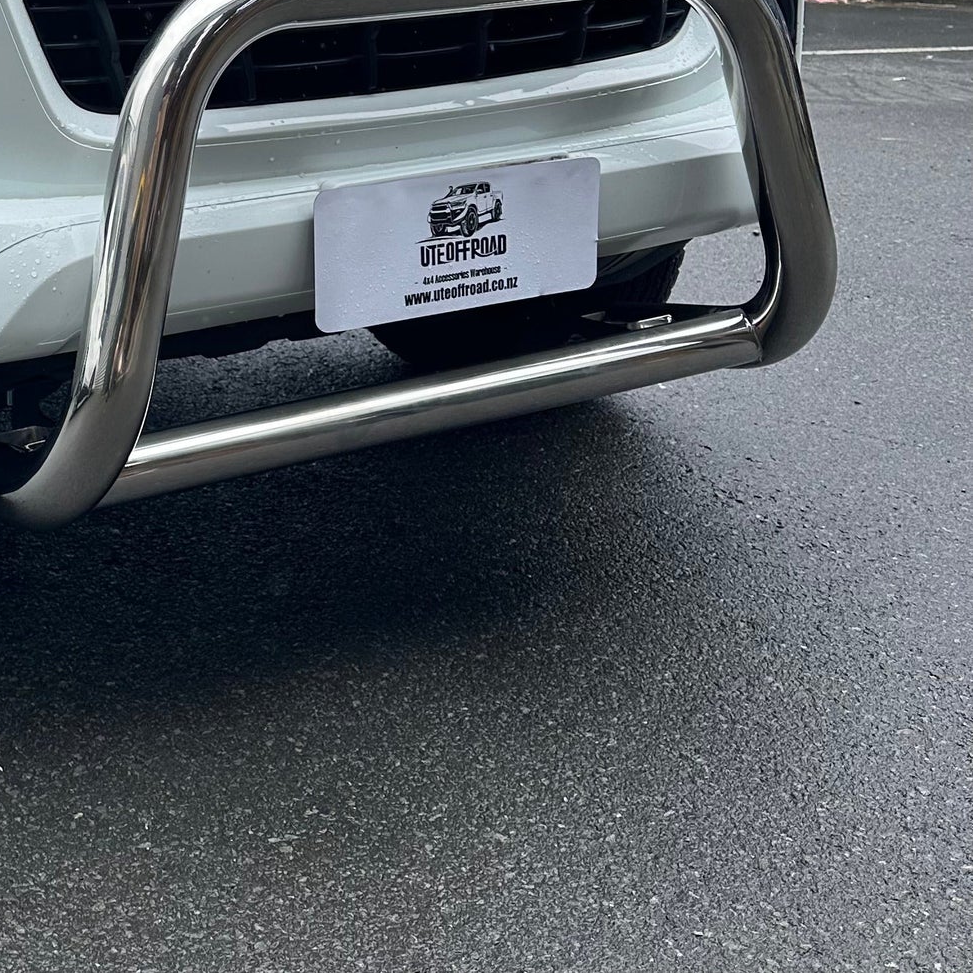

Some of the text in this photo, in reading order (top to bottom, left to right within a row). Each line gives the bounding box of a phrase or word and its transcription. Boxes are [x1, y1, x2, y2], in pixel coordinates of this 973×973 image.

[420, 234, 507, 267] UTEOFFROAD
[404, 276, 518, 307] www.uteoffroad.co.nz
[422, 266, 501, 286] 4x4 Accessories Warehouse
